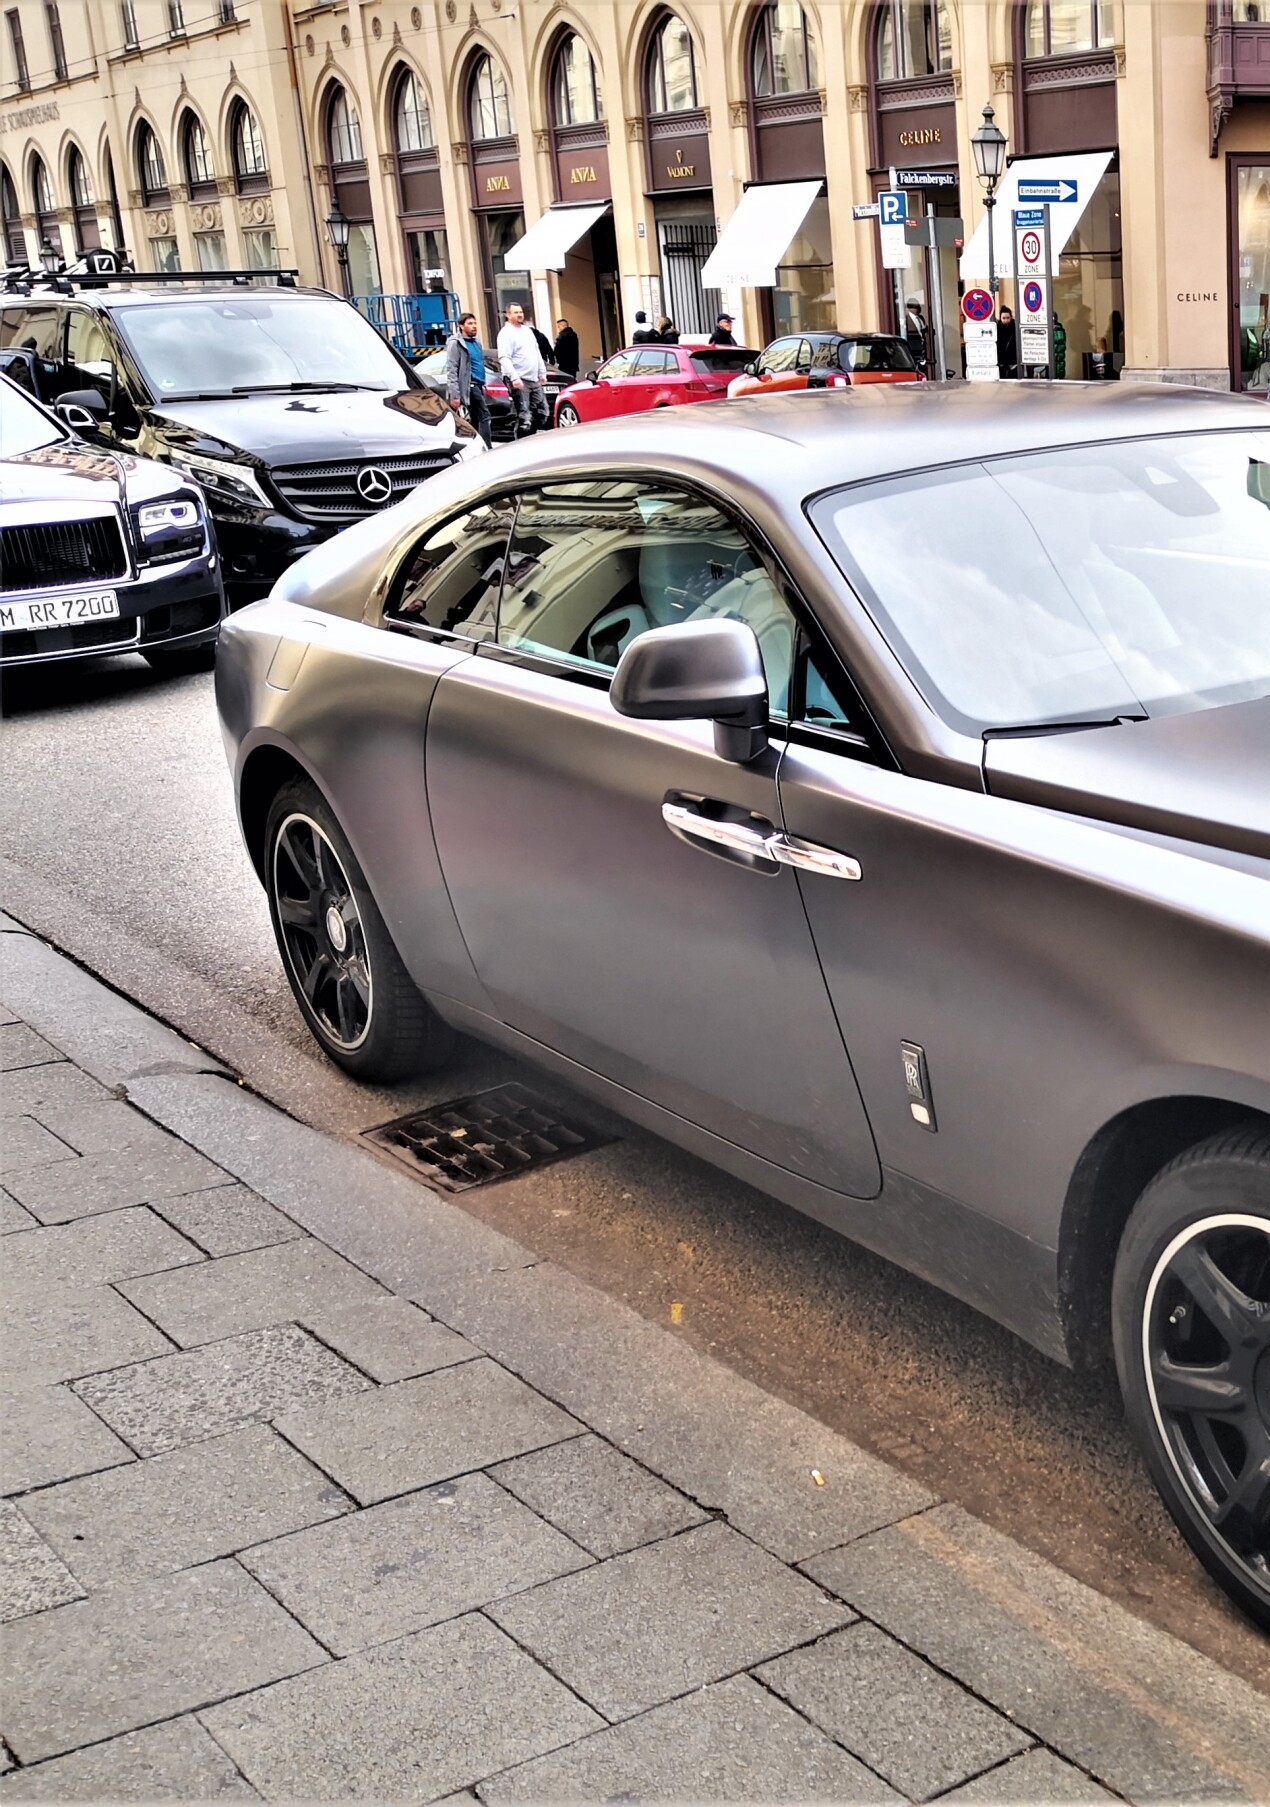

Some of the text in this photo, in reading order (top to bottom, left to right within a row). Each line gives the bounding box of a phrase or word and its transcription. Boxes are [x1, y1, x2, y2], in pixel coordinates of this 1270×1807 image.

[900, 129, 941, 146] CELINE
[900, 173, 954, 186] Falckenbergstr.
[883, 196, 899, 222] P
[1025, 240, 1037, 254] 30
[1025, 264, 1039, 273] ZONE
[1177, 293, 1218, 302] CELINE
[1026, 314, 1041, 323] ZONE
[29, 602, 58, 623] RR
[62, 596, 114, 619] 7200
